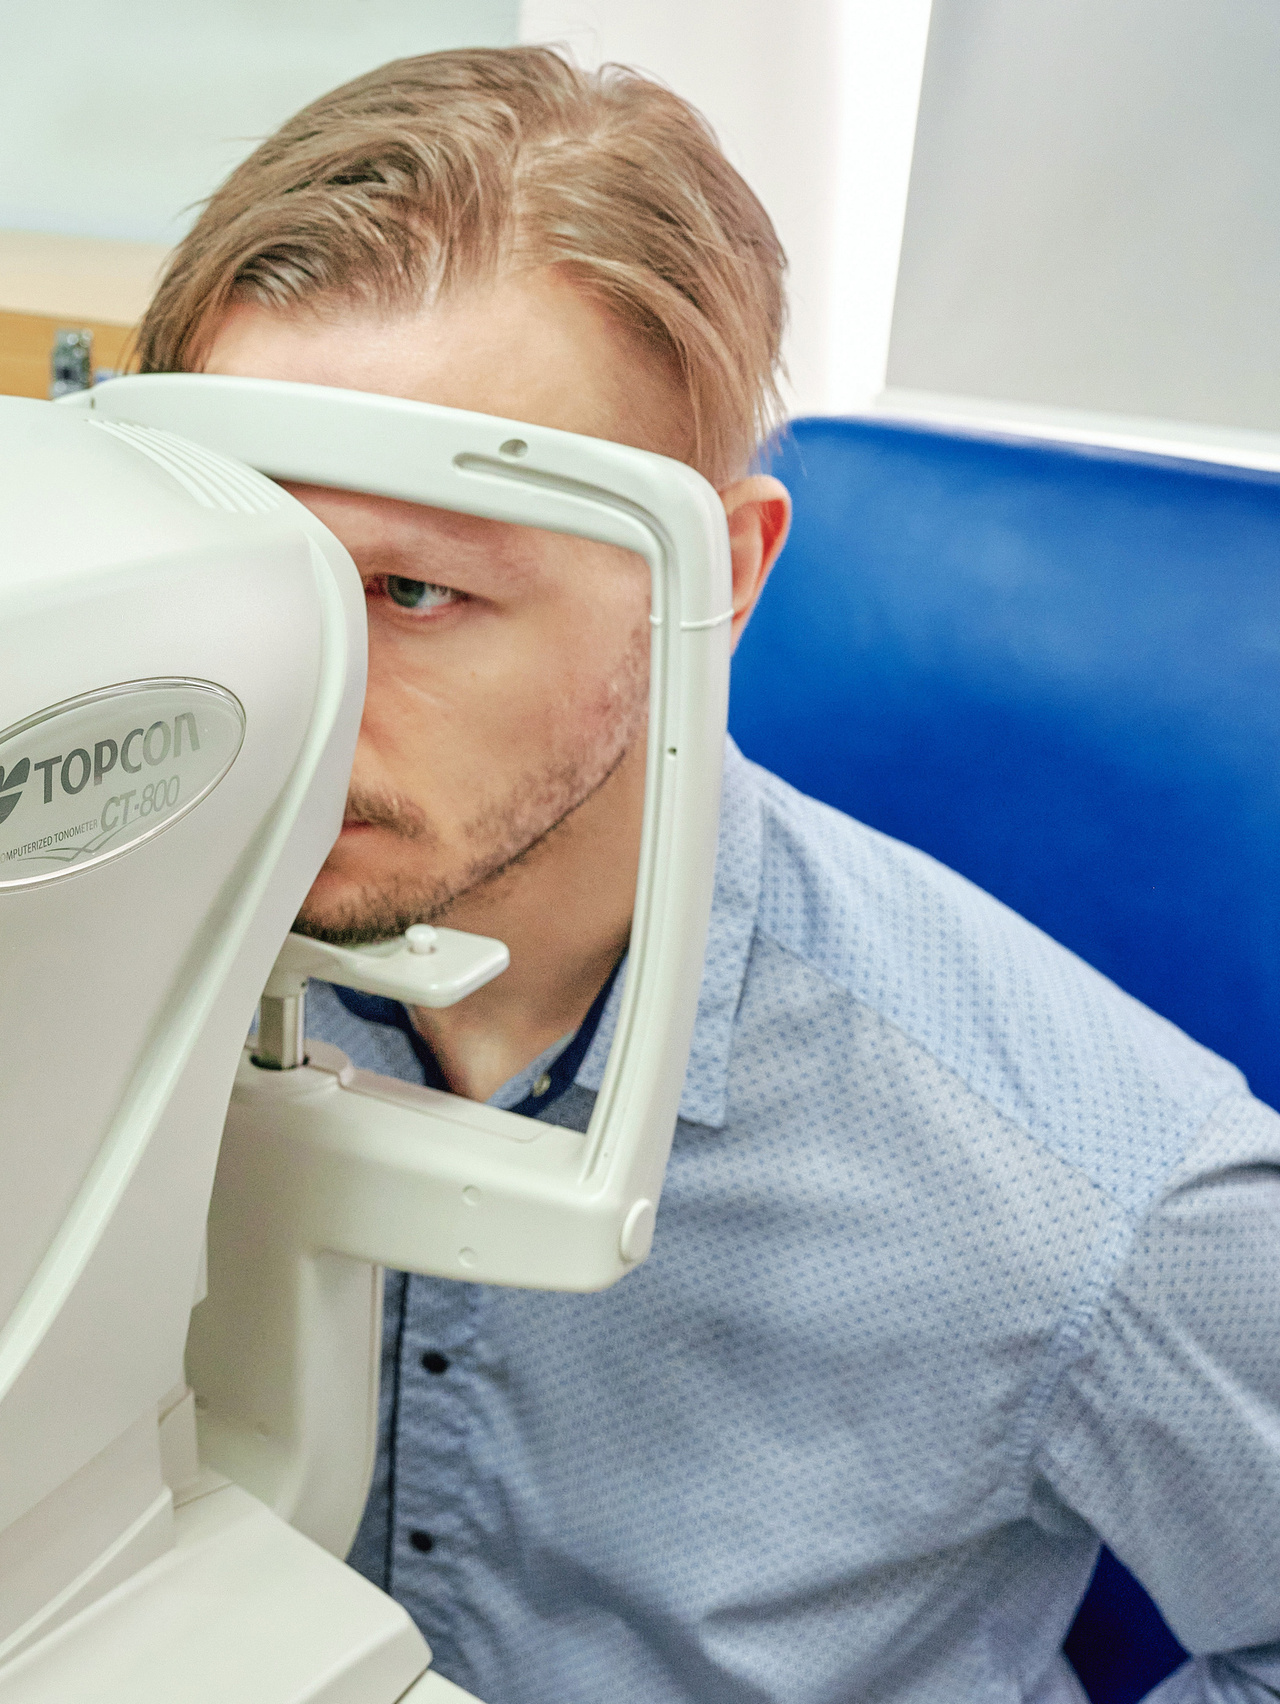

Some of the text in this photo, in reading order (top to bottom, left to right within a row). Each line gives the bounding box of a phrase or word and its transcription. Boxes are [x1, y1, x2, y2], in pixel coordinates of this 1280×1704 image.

[34, 711, 201, 805] TOPCON
[54, 818, 98, 844] TONOMETER
[100, 775, 181, 833] CT-800
